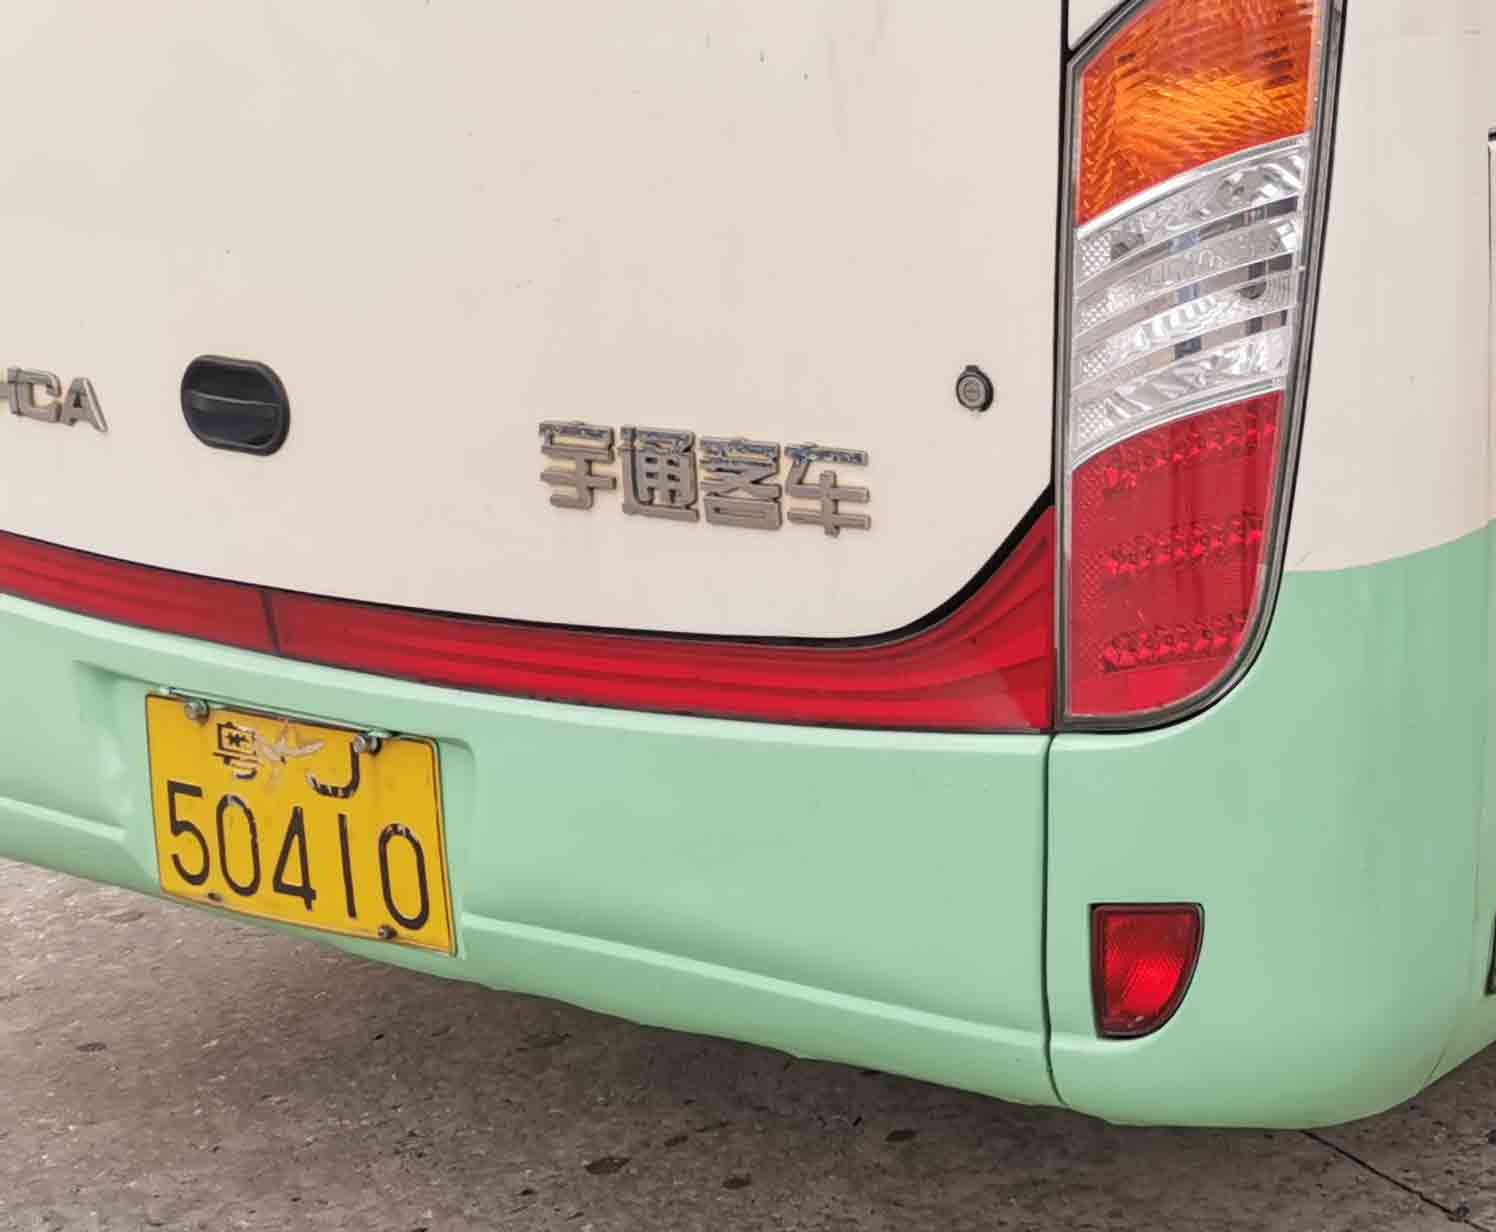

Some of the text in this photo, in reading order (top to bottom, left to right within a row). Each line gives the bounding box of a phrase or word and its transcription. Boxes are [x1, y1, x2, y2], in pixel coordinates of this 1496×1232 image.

[538, 419, 873, 538] 宇通客车
[166, 779, 430, 931] 50410
